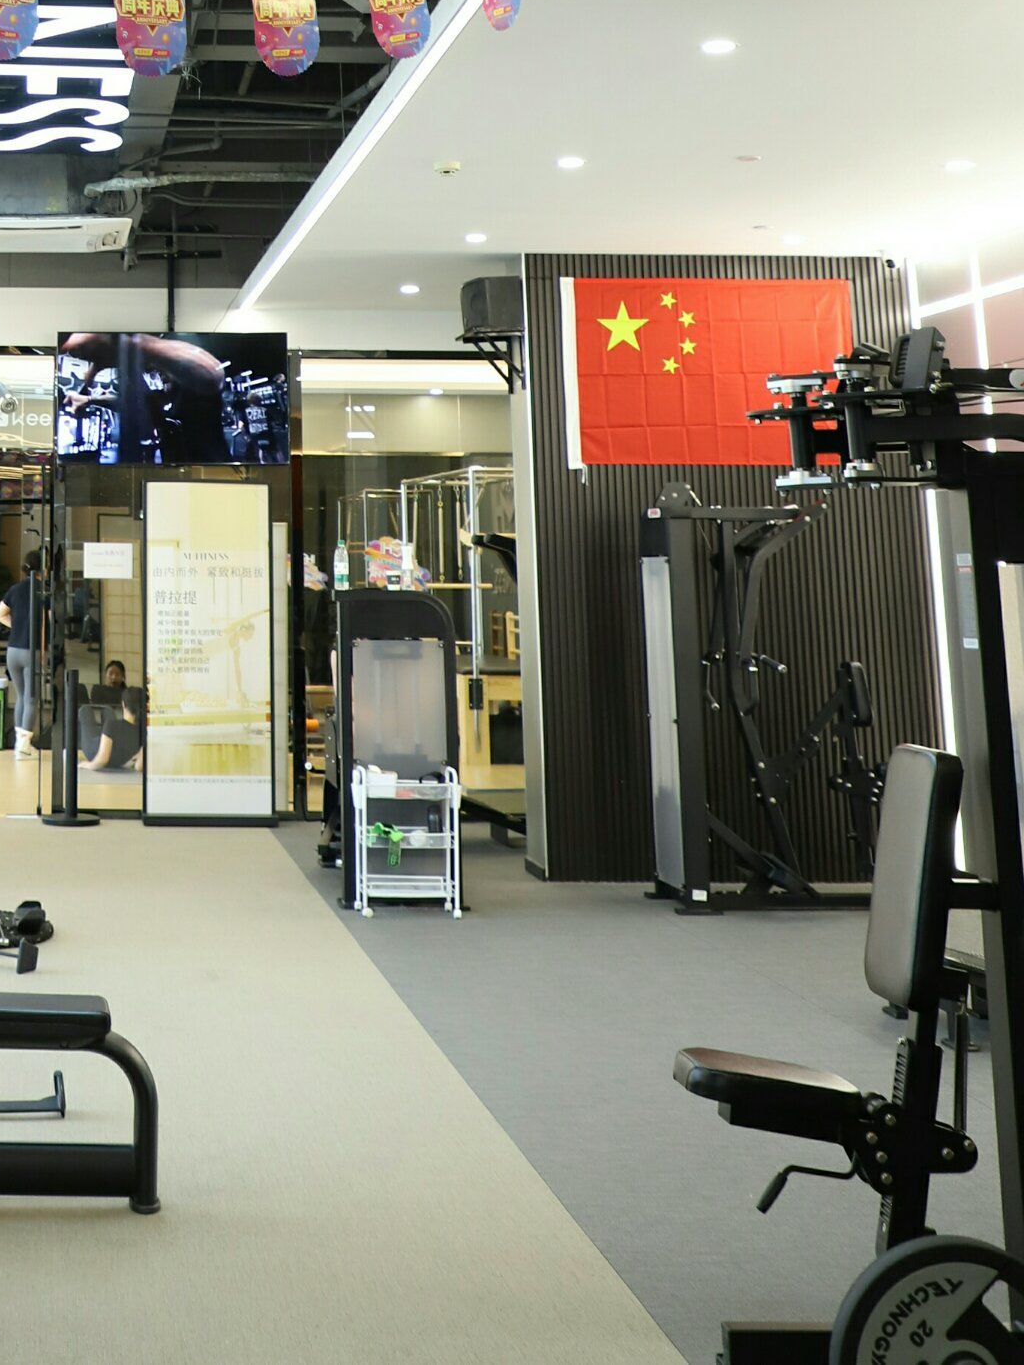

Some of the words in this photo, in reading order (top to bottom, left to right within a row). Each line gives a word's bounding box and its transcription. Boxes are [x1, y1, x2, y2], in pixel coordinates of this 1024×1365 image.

[154, 590, 197, 605] 普拉提
[872, 1277, 964, 1365] TECHNOGY
[909, 1319, 934, 1347] 20
